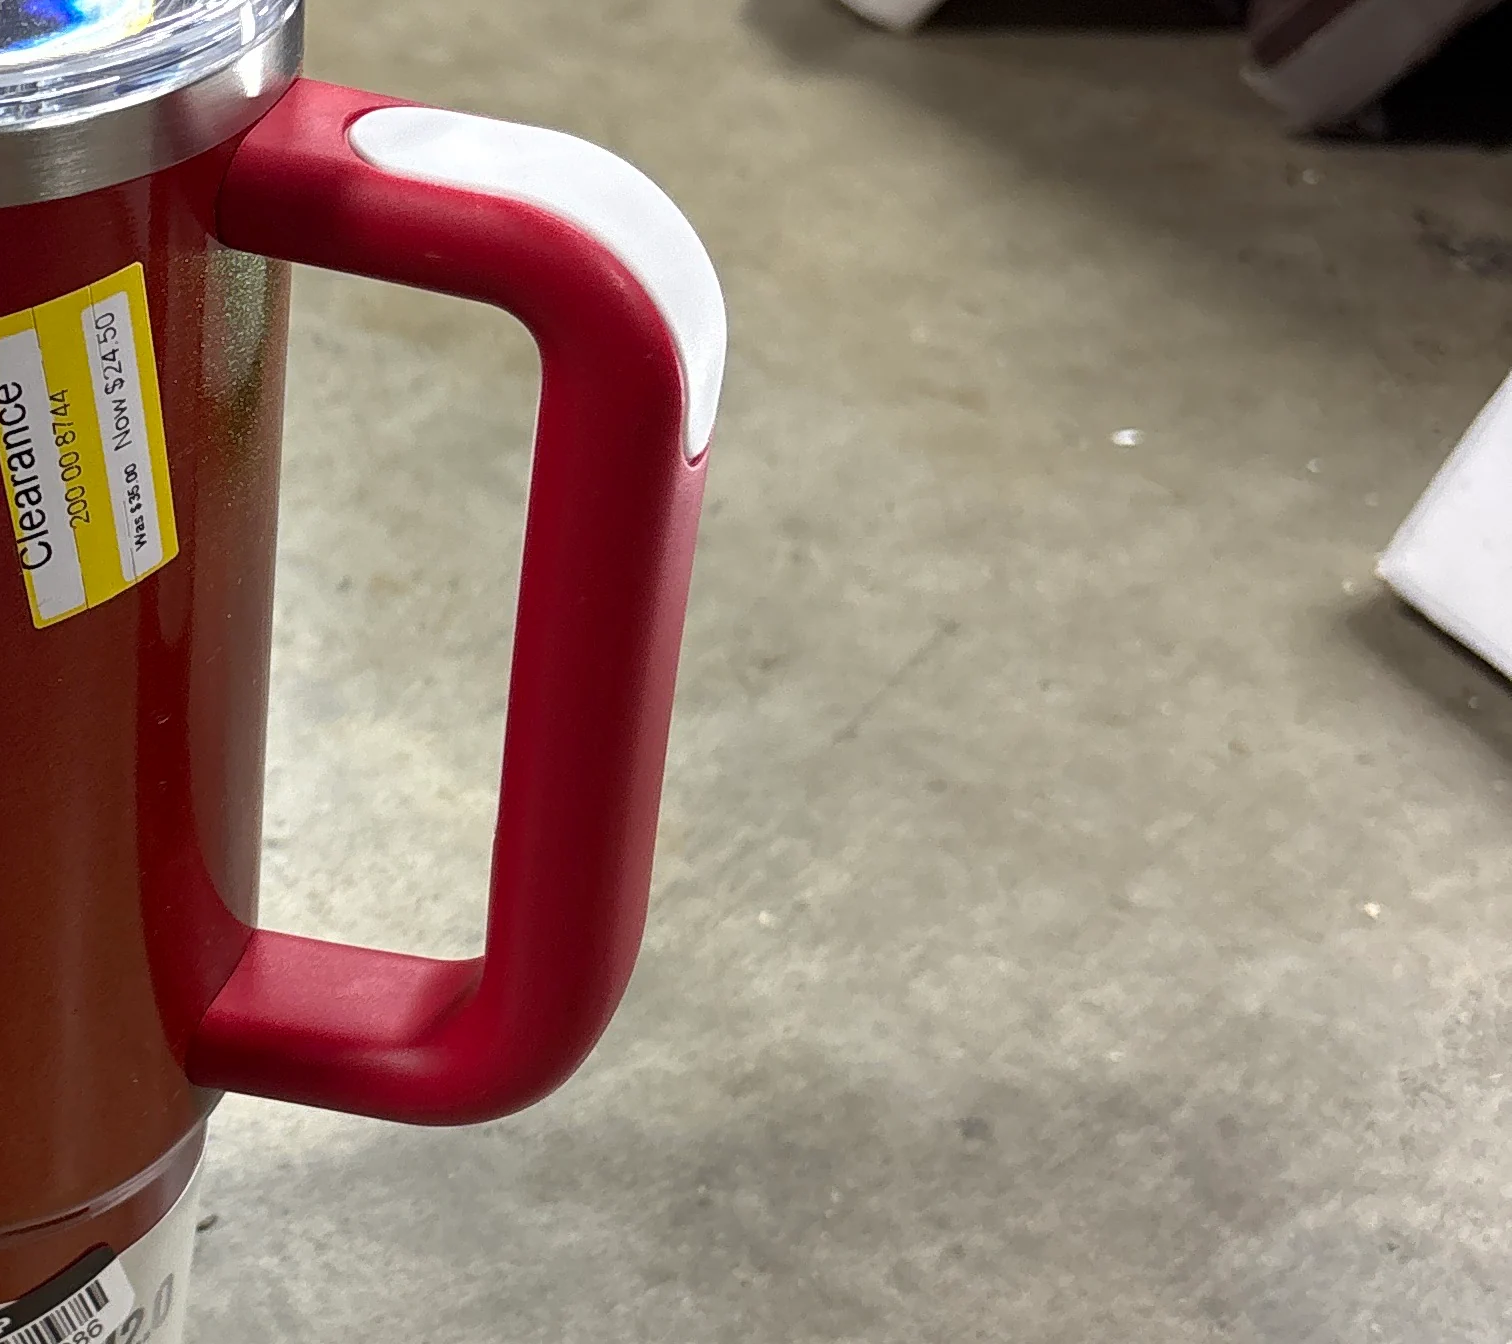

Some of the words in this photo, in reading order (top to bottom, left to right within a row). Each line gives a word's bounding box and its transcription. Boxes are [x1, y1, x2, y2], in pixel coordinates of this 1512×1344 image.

[95, 312, 126, 395] $24.50
[50, 388, 76, 447] 8744
[112, 398, 132, 452] Now
[59, 451, 82, 482] 00
[124, 462, 142, 514] $35.00
[65, 485, 91, 528] 200
[134, 514, 148, 552] Was
